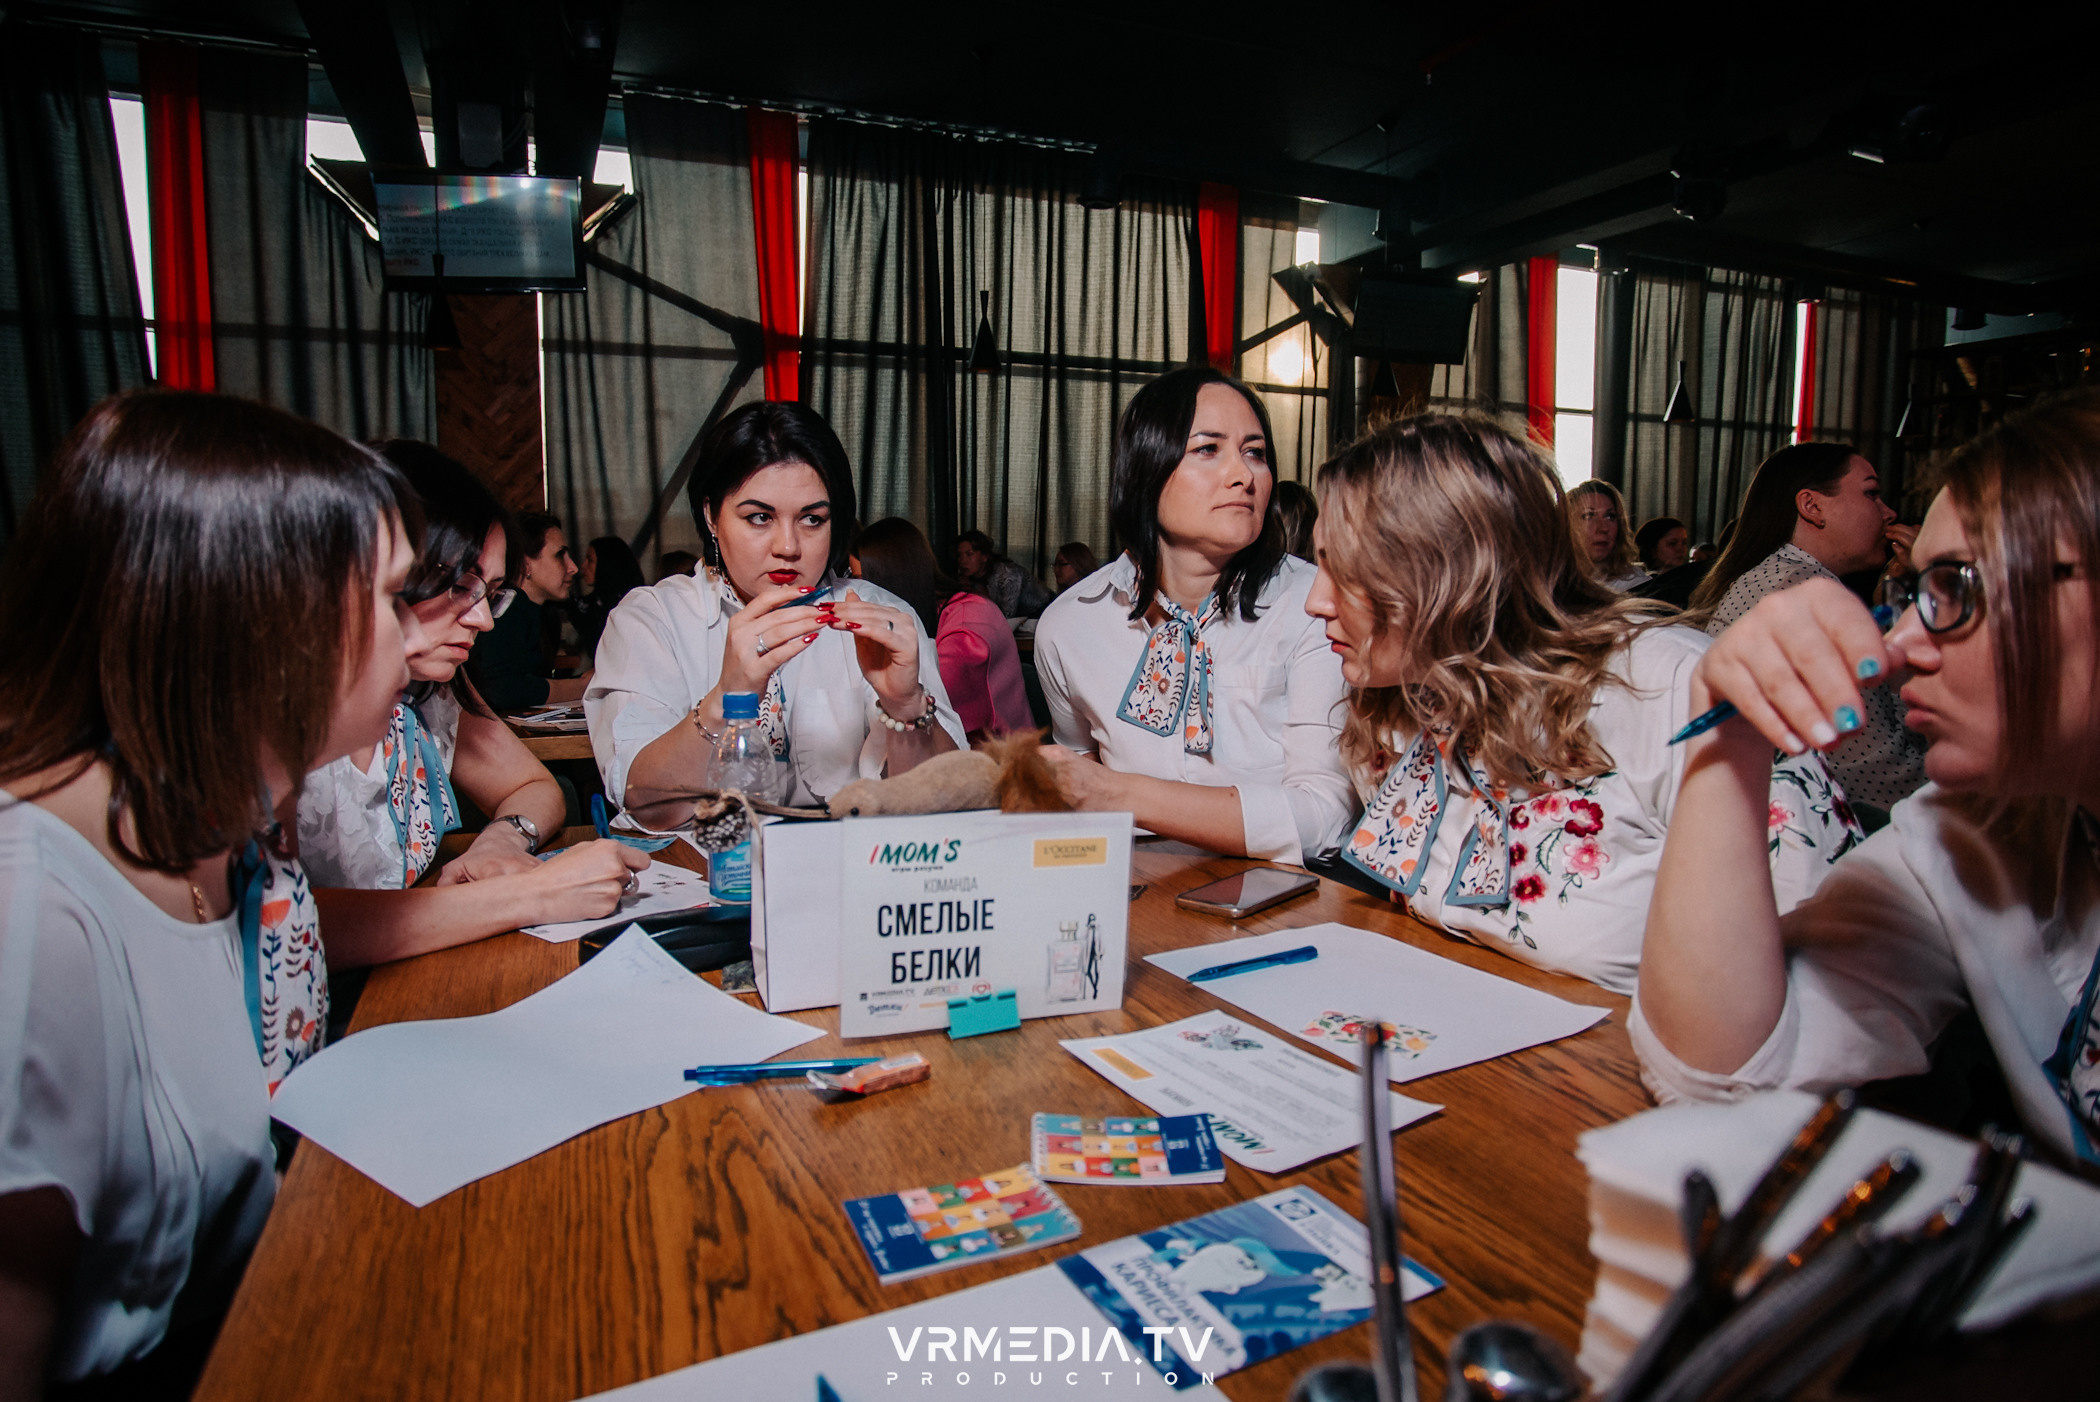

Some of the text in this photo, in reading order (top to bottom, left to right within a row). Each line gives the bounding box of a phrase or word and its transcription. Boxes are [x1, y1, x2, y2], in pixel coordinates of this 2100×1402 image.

[923, 876, 978, 893] КОМАНДА
[877, 898, 995, 938] СМЕЛЫЕ
[891, 946, 981, 984] БЕЛКИ
[1111, 1262, 1180, 1327] КАРИЕСА
